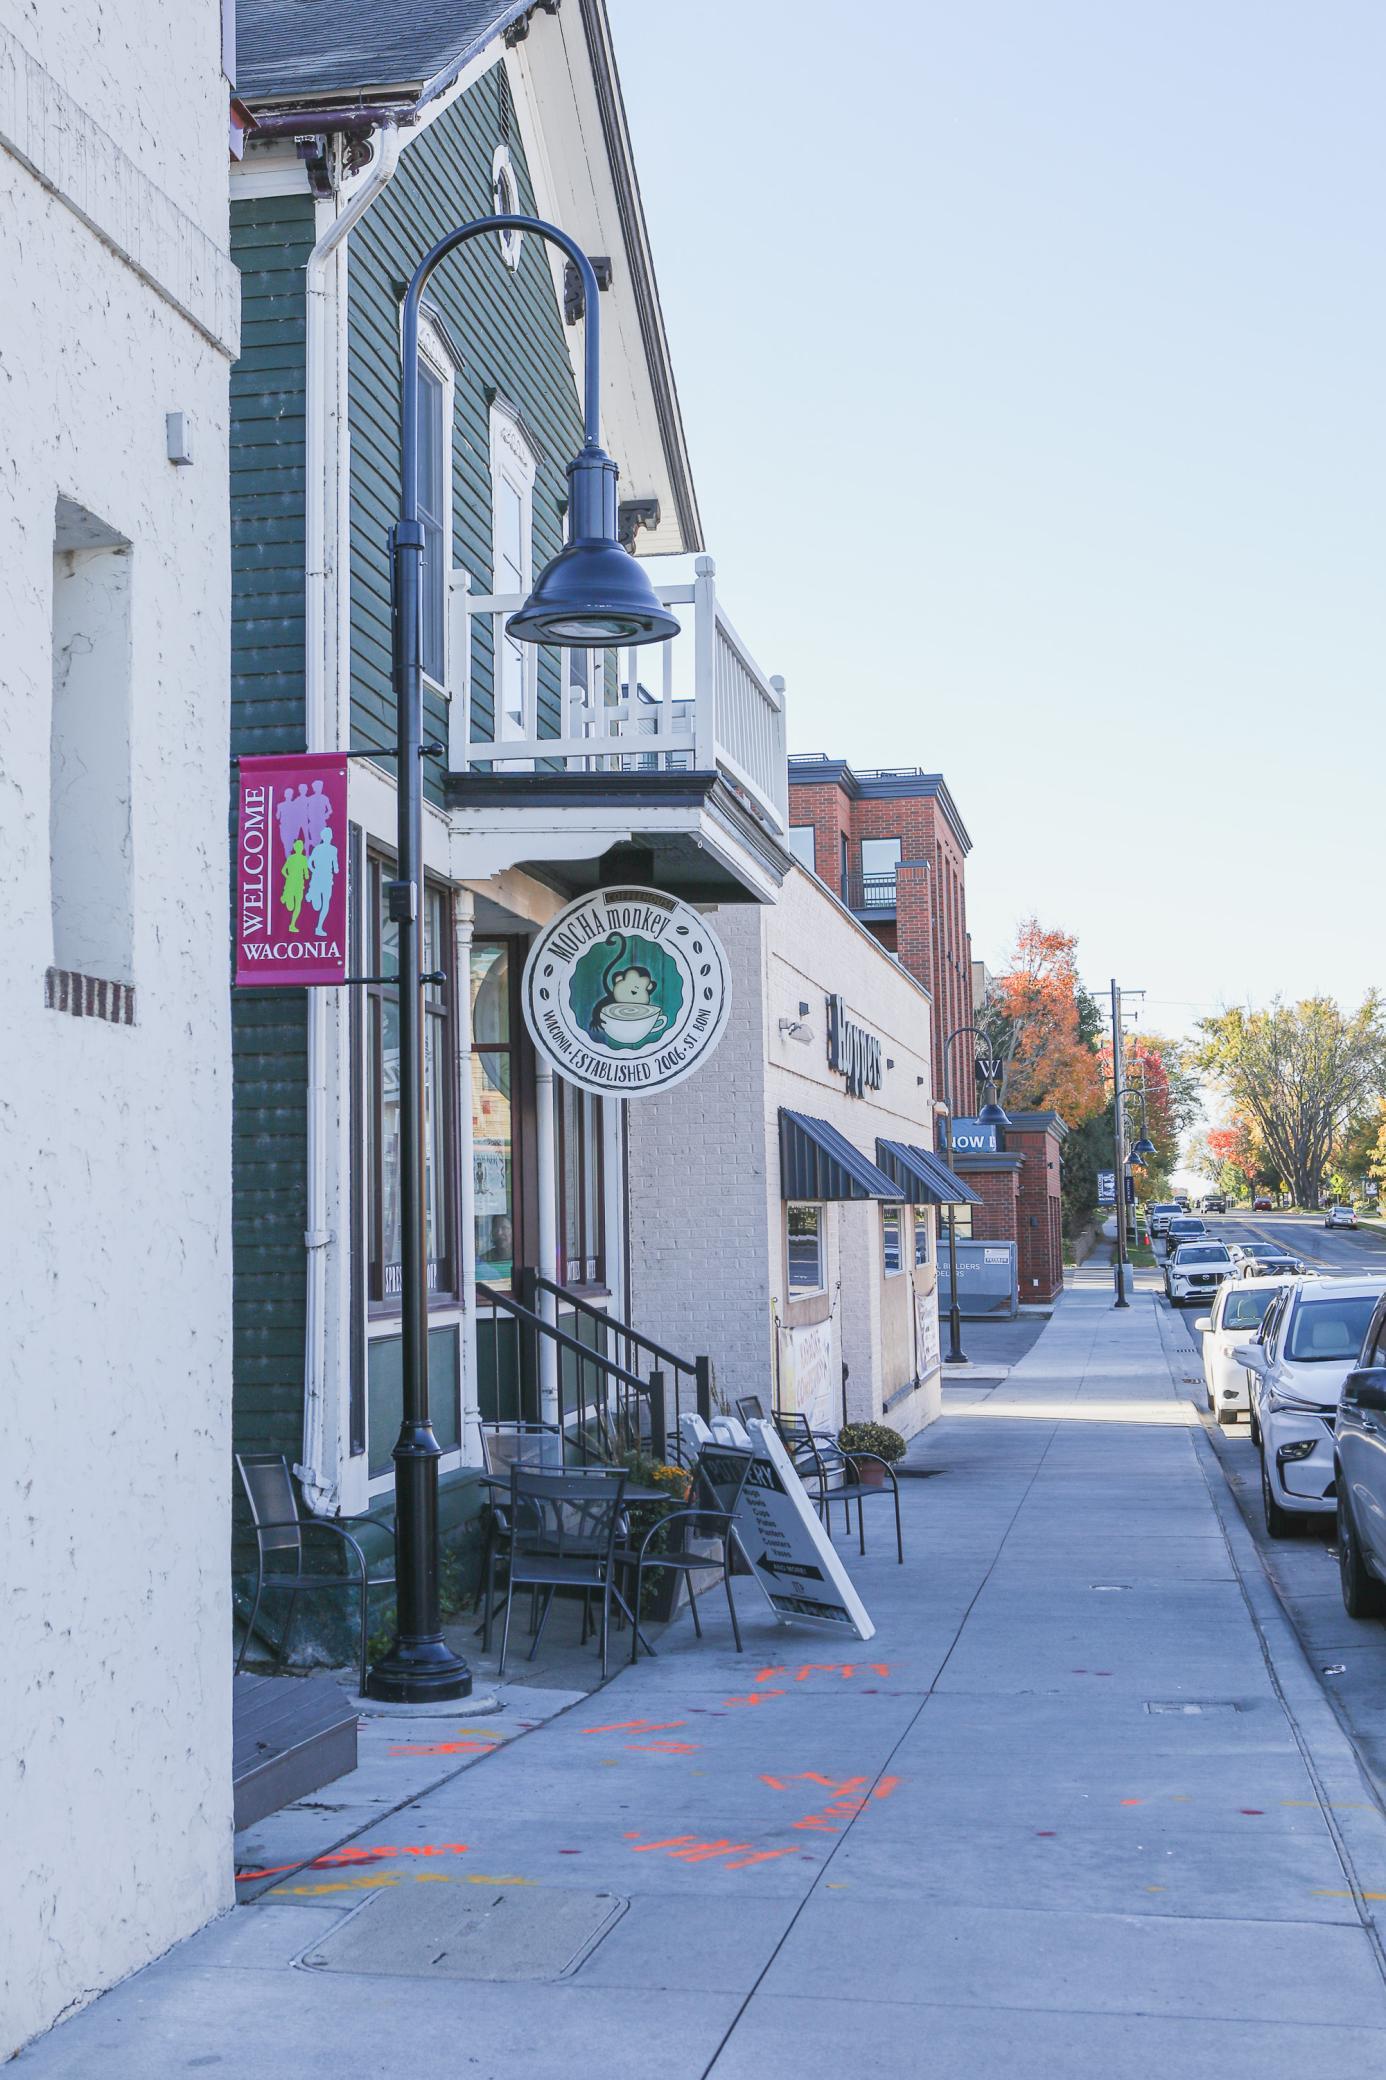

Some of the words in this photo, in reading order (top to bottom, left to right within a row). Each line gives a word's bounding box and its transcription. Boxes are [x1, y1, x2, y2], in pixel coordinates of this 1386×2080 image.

[242, 786, 265, 938] WELCOME
[242, 940, 342, 960] WACONIA
[547, 908, 606, 965] MOCHA
[606, 906, 671, 939] monkey
[543, 1010, 572, 1054] WACONIA
[569, 1048, 651, 1082] ESTABLISHED
[654, 1046, 686, 1075] 2006
[695, 1008, 712, 1033] BONI
[830, 993, 882, 1099] Hoppers
